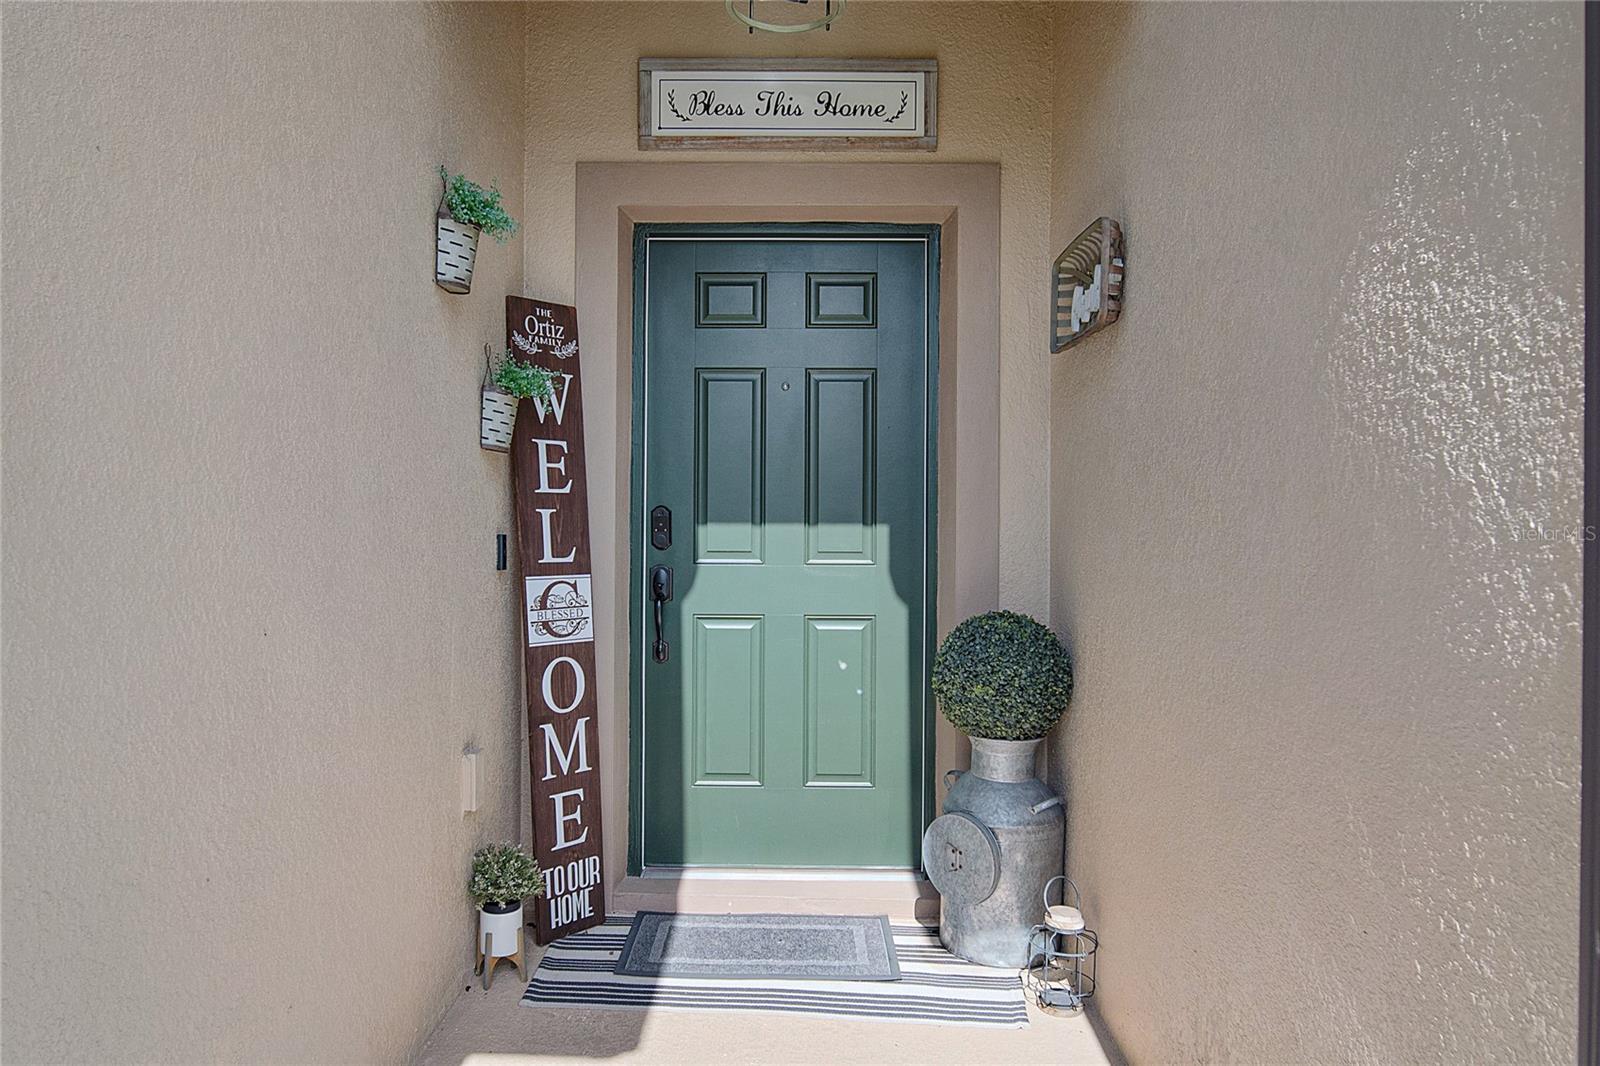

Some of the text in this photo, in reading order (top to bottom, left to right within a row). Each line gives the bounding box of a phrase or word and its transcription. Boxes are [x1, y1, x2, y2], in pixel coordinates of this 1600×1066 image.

[688, 90, 887, 117] Bless This Home
[535, 308, 552, 319] THE
[524, 315, 565, 339] Ortiz
[528, 334, 563, 347] FAMILY
[531, 371, 592, 851] WELCOME
[537, 608, 584, 620] BLESSED
[542, 855, 601, 899] TO OUR
[550, 887, 594, 929] HOME
